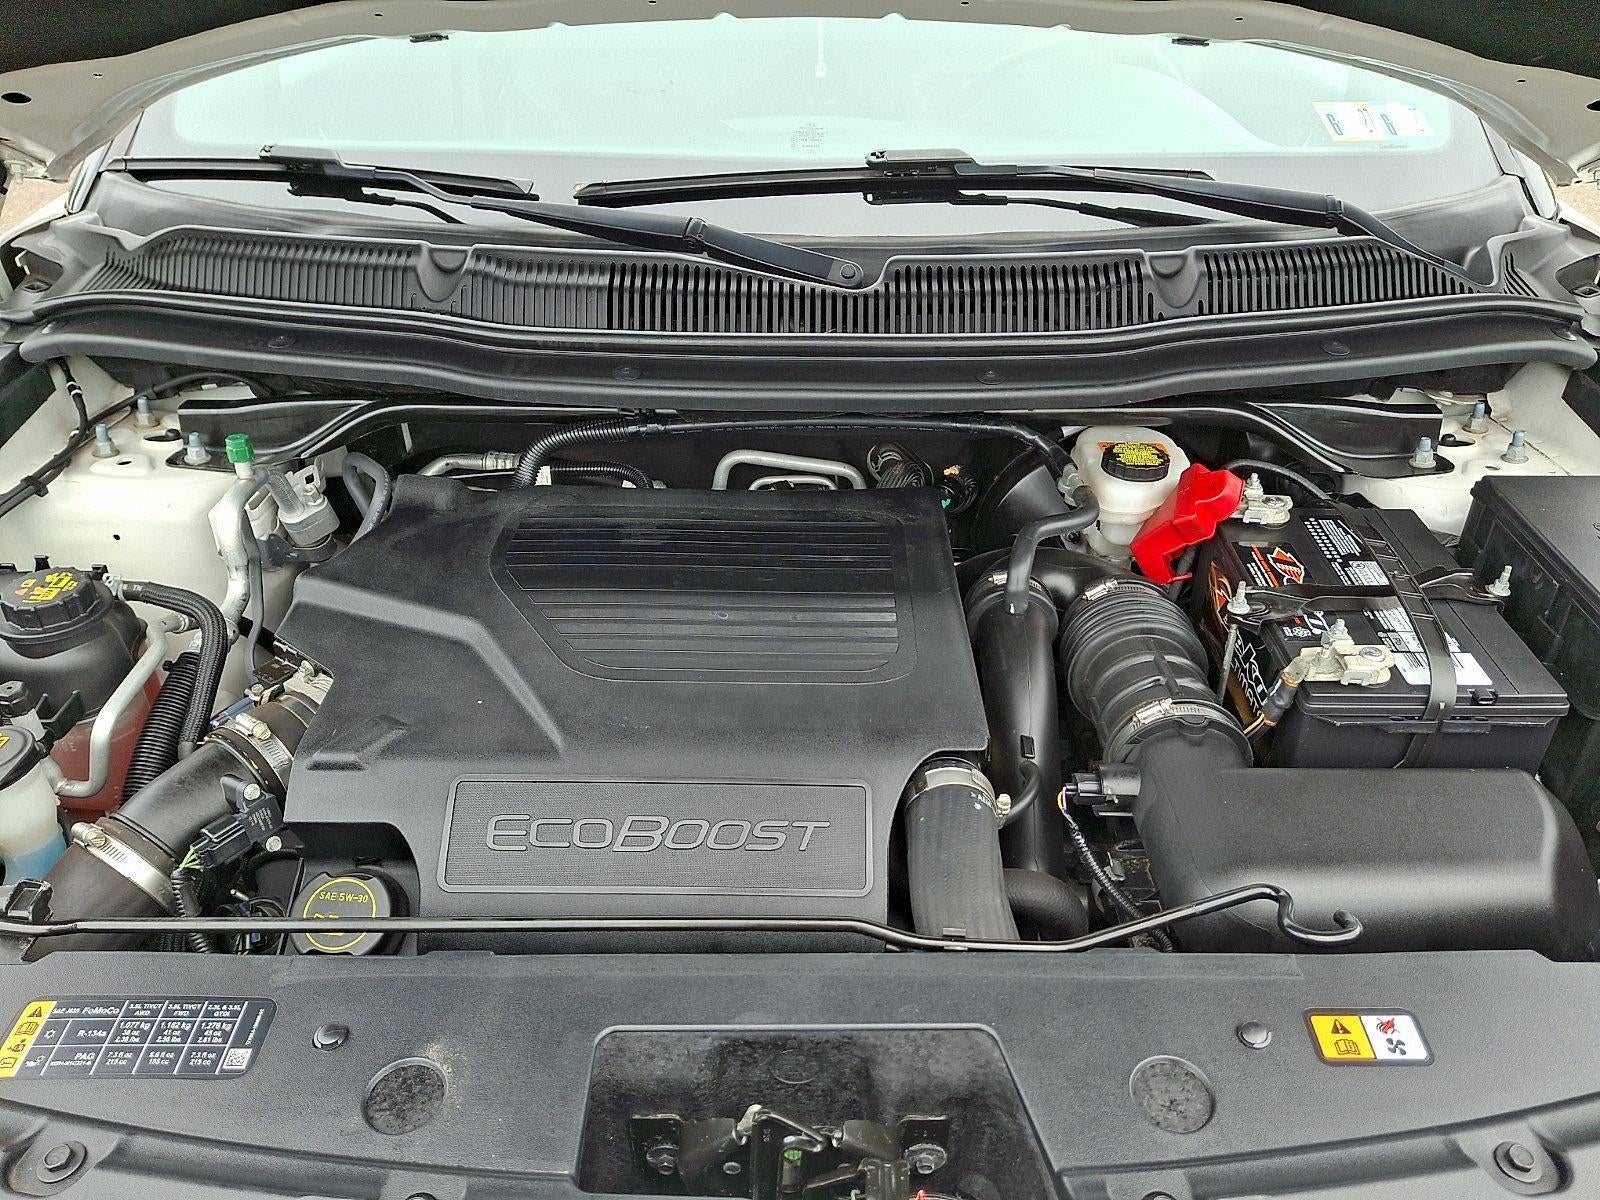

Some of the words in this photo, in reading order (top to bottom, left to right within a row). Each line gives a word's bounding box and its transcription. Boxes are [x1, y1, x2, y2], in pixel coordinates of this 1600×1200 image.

[319, 891, 337, 901] SAE
[338, 893, 369, 903] 5W-30
[82, 1006, 119, 1014] FoMoCo
[140, 1021, 151, 1030] kg
[181, 1021, 192, 1031] kg
[221, 1022, 232, 1032] kg
